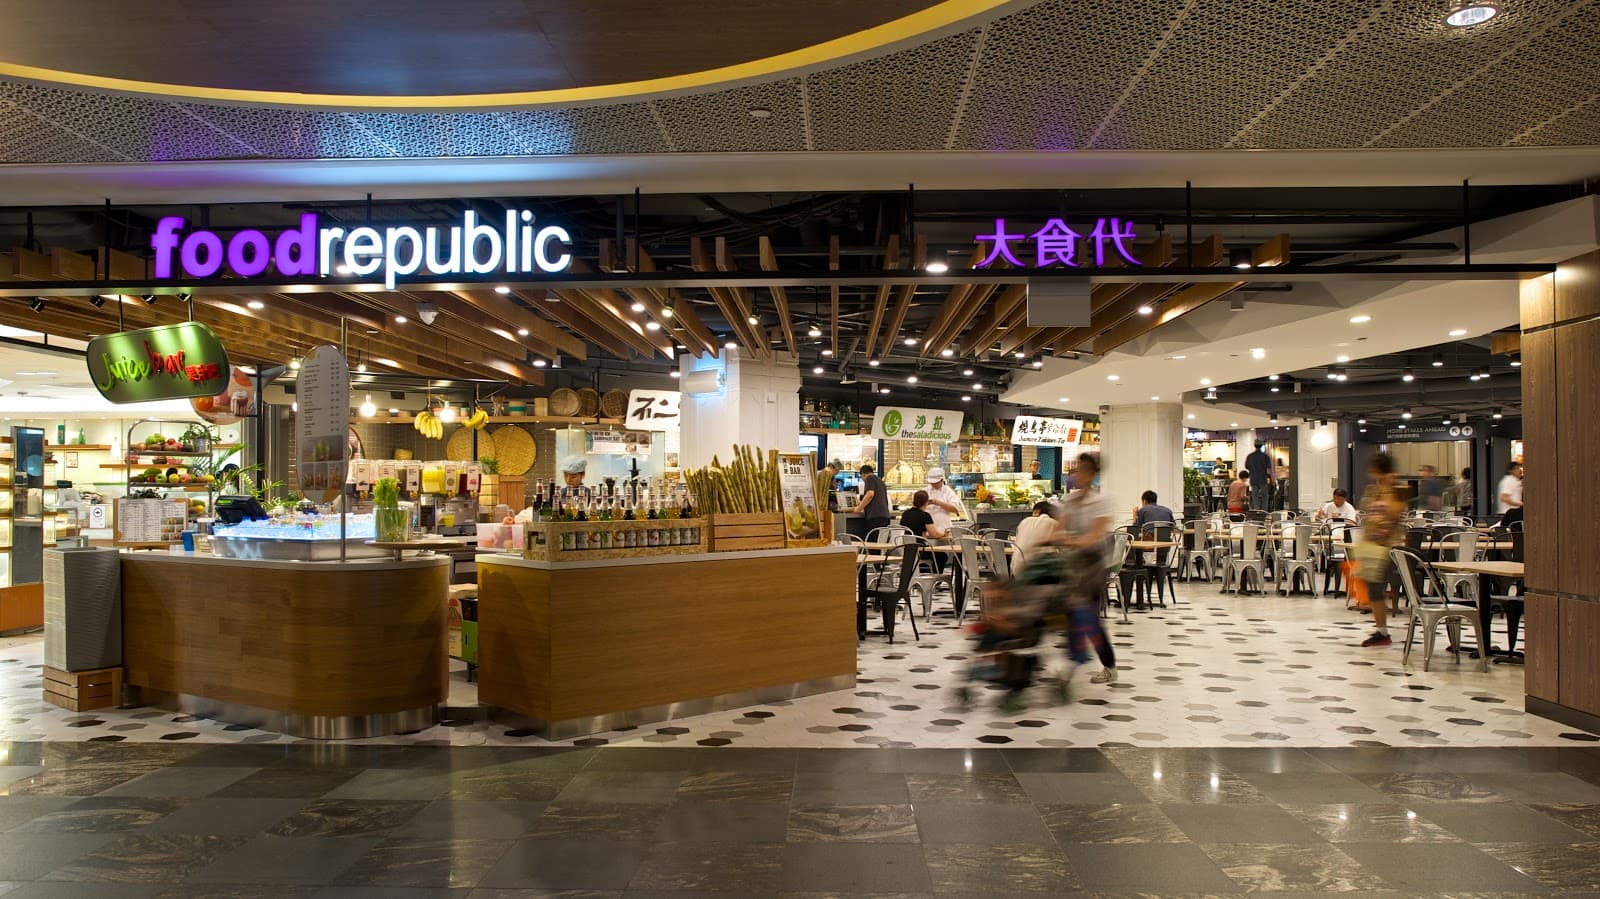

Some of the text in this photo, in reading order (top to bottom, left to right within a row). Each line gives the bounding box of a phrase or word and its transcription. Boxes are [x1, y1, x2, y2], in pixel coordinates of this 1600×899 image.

[975, 217, 1143, 268] 大食代
[915, 415, 944, 430] 沙拉
